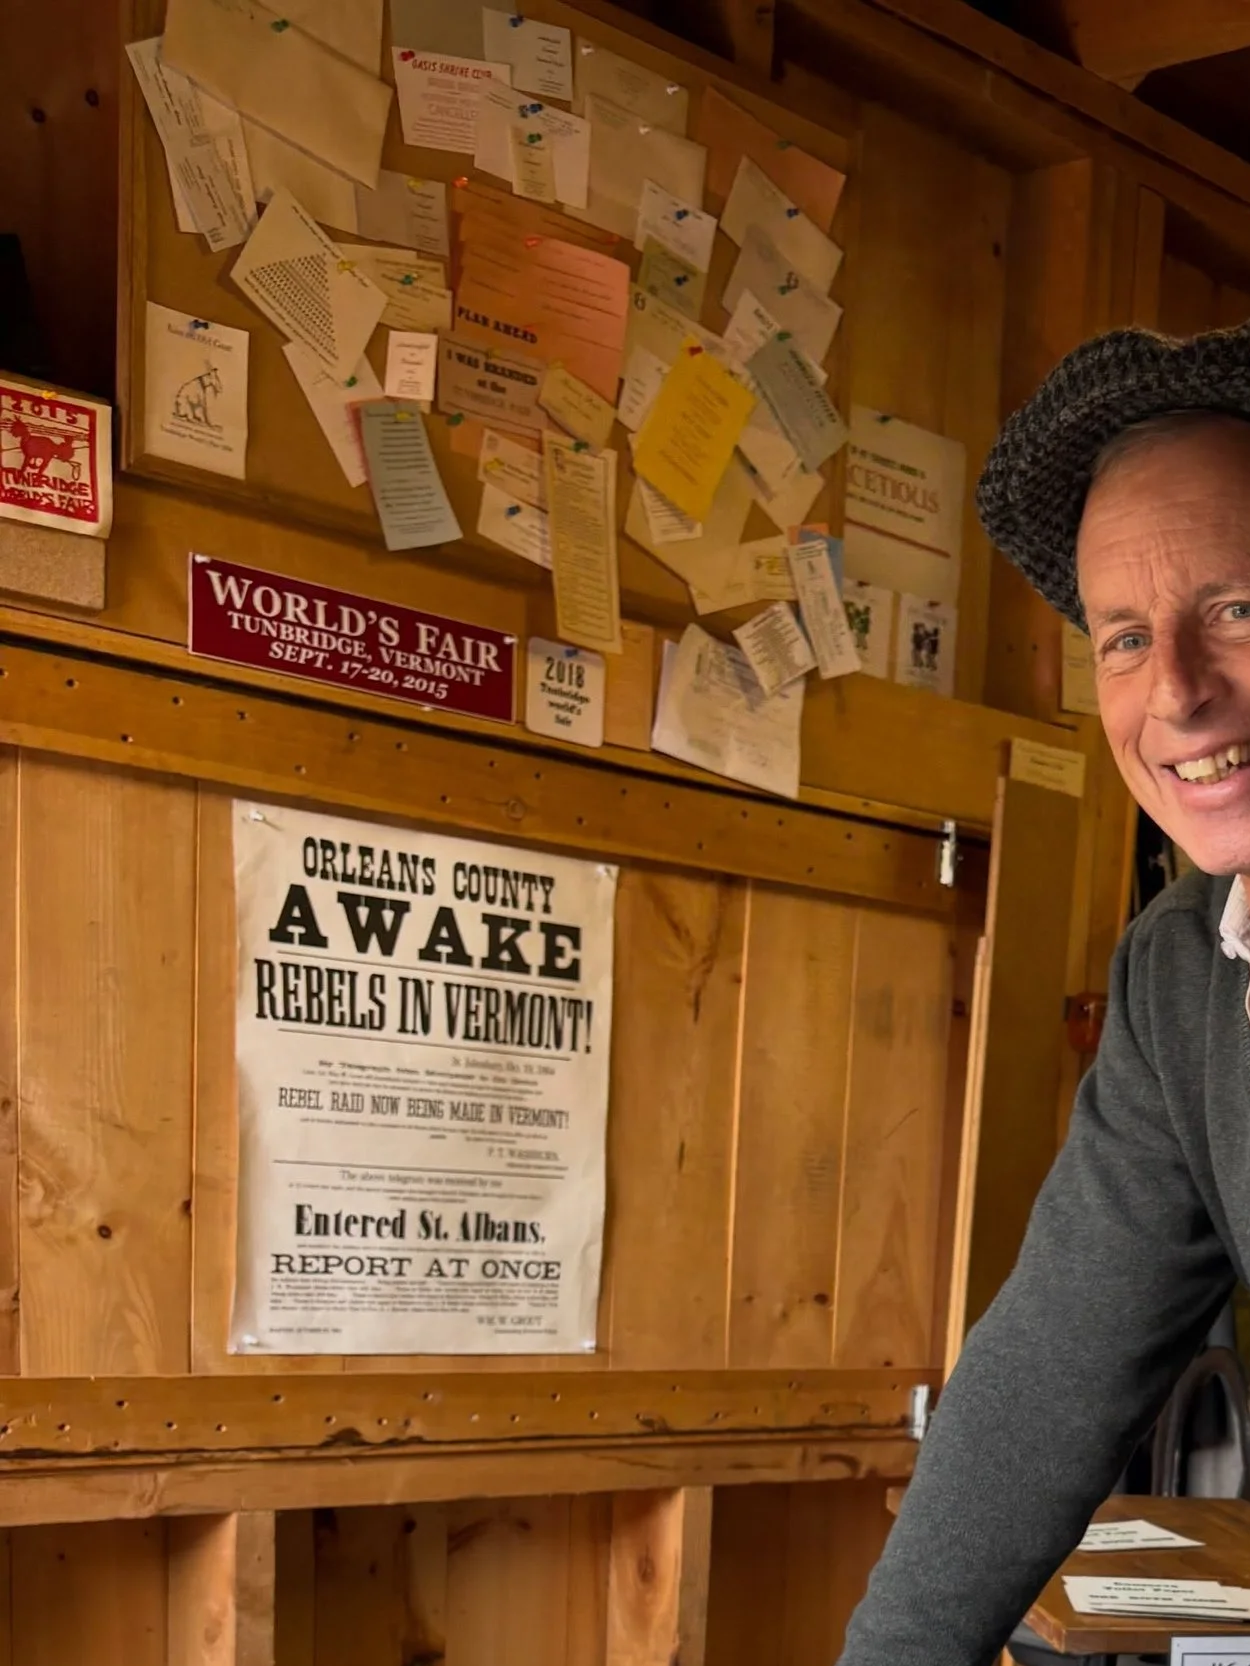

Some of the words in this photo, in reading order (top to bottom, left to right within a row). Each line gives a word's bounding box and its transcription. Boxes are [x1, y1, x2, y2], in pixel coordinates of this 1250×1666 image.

[457, 305, 489, 328] PLAN
[492, 319, 538, 344] AHEAD
[11, 398, 79, 425] 2015
[3, 470, 90, 498] TUNBRIDGE
[206, 569, 401, 647] WORLD'S
[416, 622, 503, 673] FAIR
[227, 610, 373, 664] TUNBRIDGE,
[379, 647, 486, 687] VERMONT
[269, 641, 334, 671] SEPT.
[339, 661, 400, 689] 17-20,
[401, 674, 450, 700] 2015
[545, 656, 586, 689] 2018
[302, 836, 437, 896] ORLEANS
[452, 862, 555, 915] COUNTY
[268, 883, 582, 982] AWAKE
[254, 957, 387, 1034] REBELS
[397, 976, 436, 1037] IN
[443, 982, 595, 1055] VERMONT!
[278, 1087, 324, 1110] REBEL
[330, 1091, 365, 1113] RAID
[371, 1094, 401, 1115] NOW
[406, 1097, 445, 1120] BEING
[449, 1100, 486, 1122] MADE
[489, 1104, 505, 1124] IN
[508, 1105, 570, 1130] VERMONT!
[295, 1204, 406, 1240] Entered
[417, 1207, 449, 1241] St.
[271, 1253, 413, 1277] REPORT
[424, 1257, 470, 1279] AT
[481, 1259, 562, 1280] ONCE
